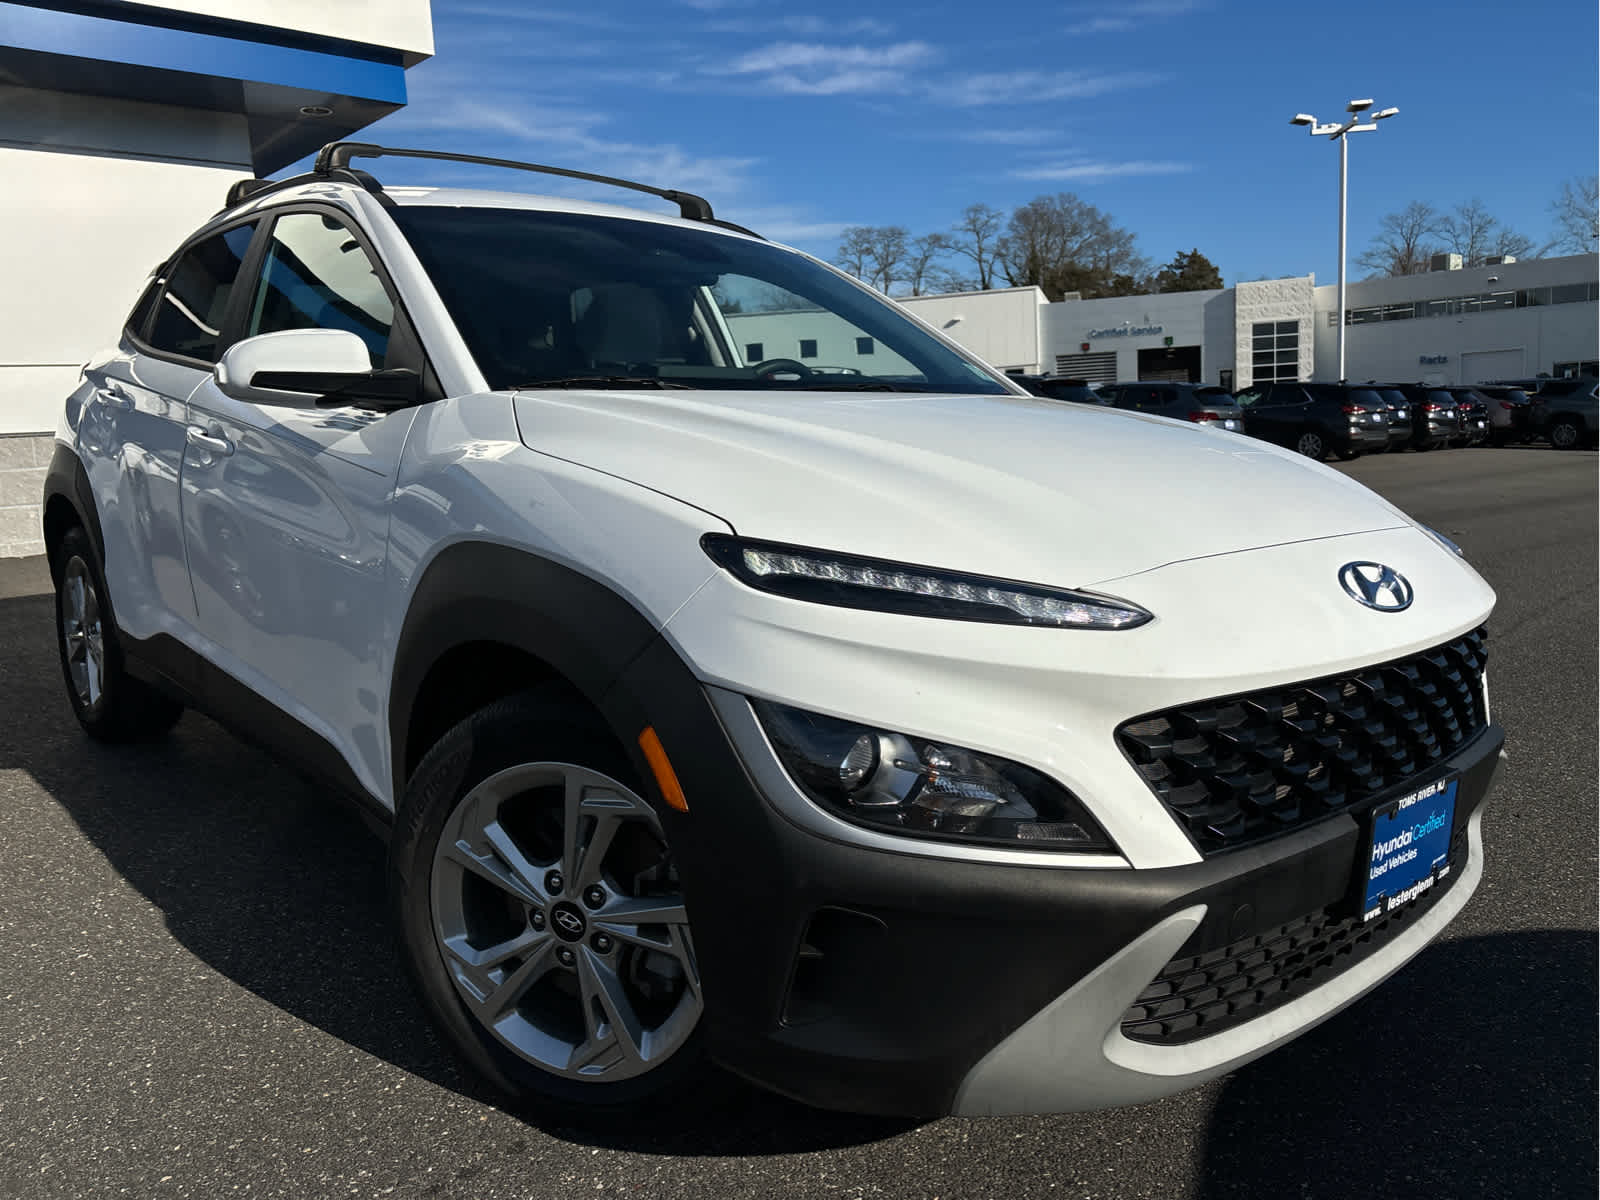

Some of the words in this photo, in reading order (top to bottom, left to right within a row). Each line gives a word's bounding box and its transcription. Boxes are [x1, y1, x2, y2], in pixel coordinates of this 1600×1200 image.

[1131, 325, 1163, 336] Service
[1398, 793, 1417, 810] TOMS
[1372, 827, 1414, 861] Hyundai
[1413, 809, 1446, 841] Certified
[1370, 860, 1388, 880] Used
[1388, 848, 1418, 870] Vehicles
[1387, 875, 1434, 911] lesterglenn
